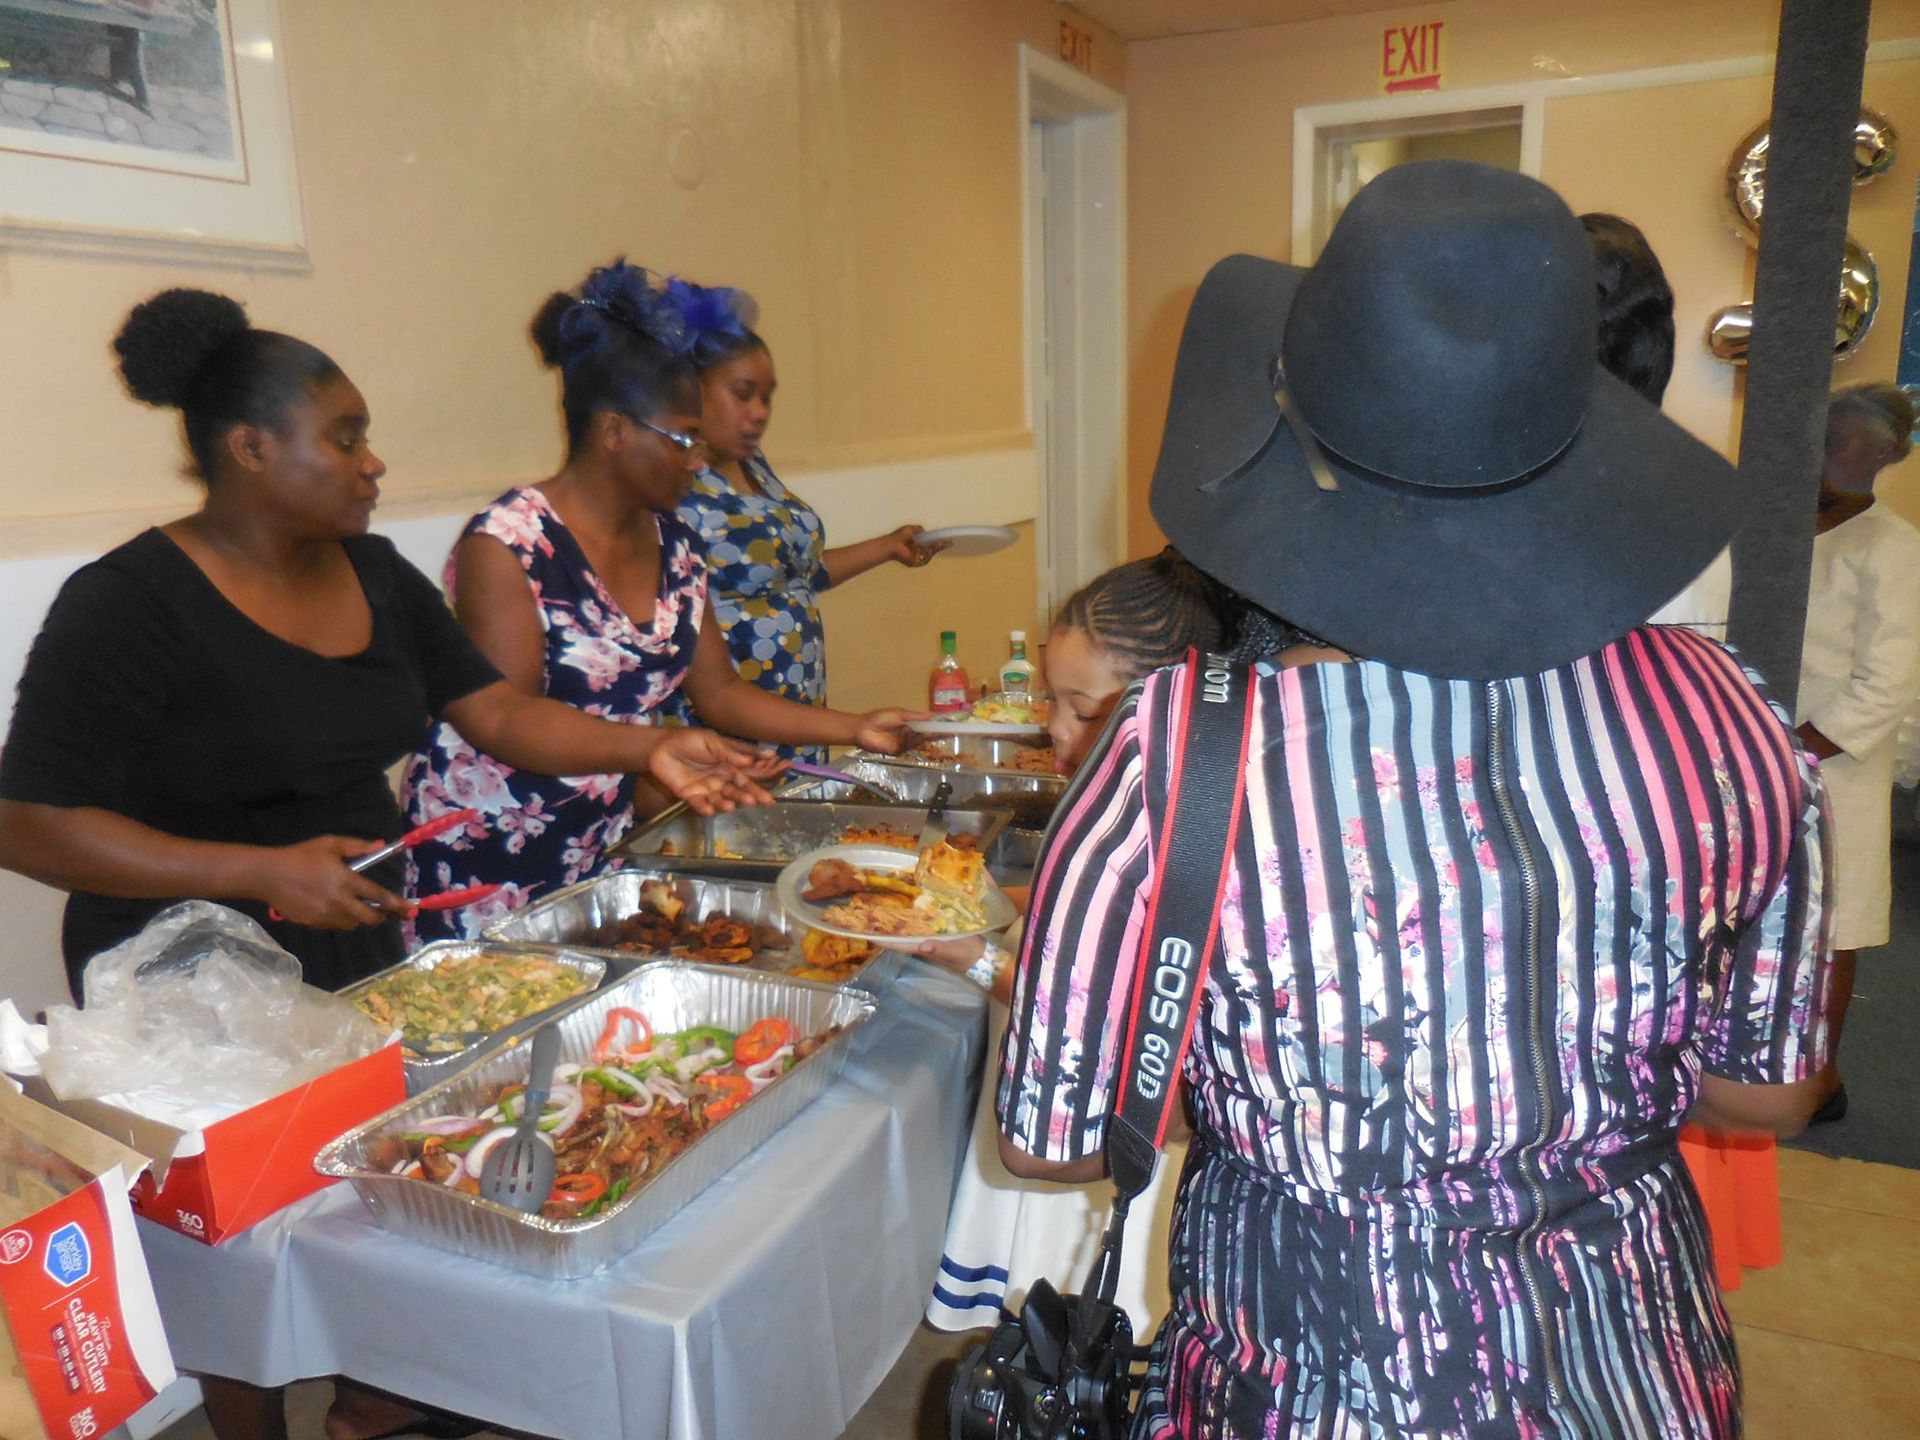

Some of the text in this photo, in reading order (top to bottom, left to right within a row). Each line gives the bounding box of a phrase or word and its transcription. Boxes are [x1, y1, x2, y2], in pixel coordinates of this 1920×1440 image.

[1059, 20, 1093, 73] EXIT
[1383, 22, 1444, 76] EXIT
[1137, 937, 1192, 1100] EOS 60D
[176, 1209, 203, 1229] 360
[69, 1298, 88, 1340] CLEAR
[82, 1341, 106, 1394] CUTLERY
[87, 1313, 109, 1366] HEAVY DUTY
[79, 1406, 96, 1437] 360
